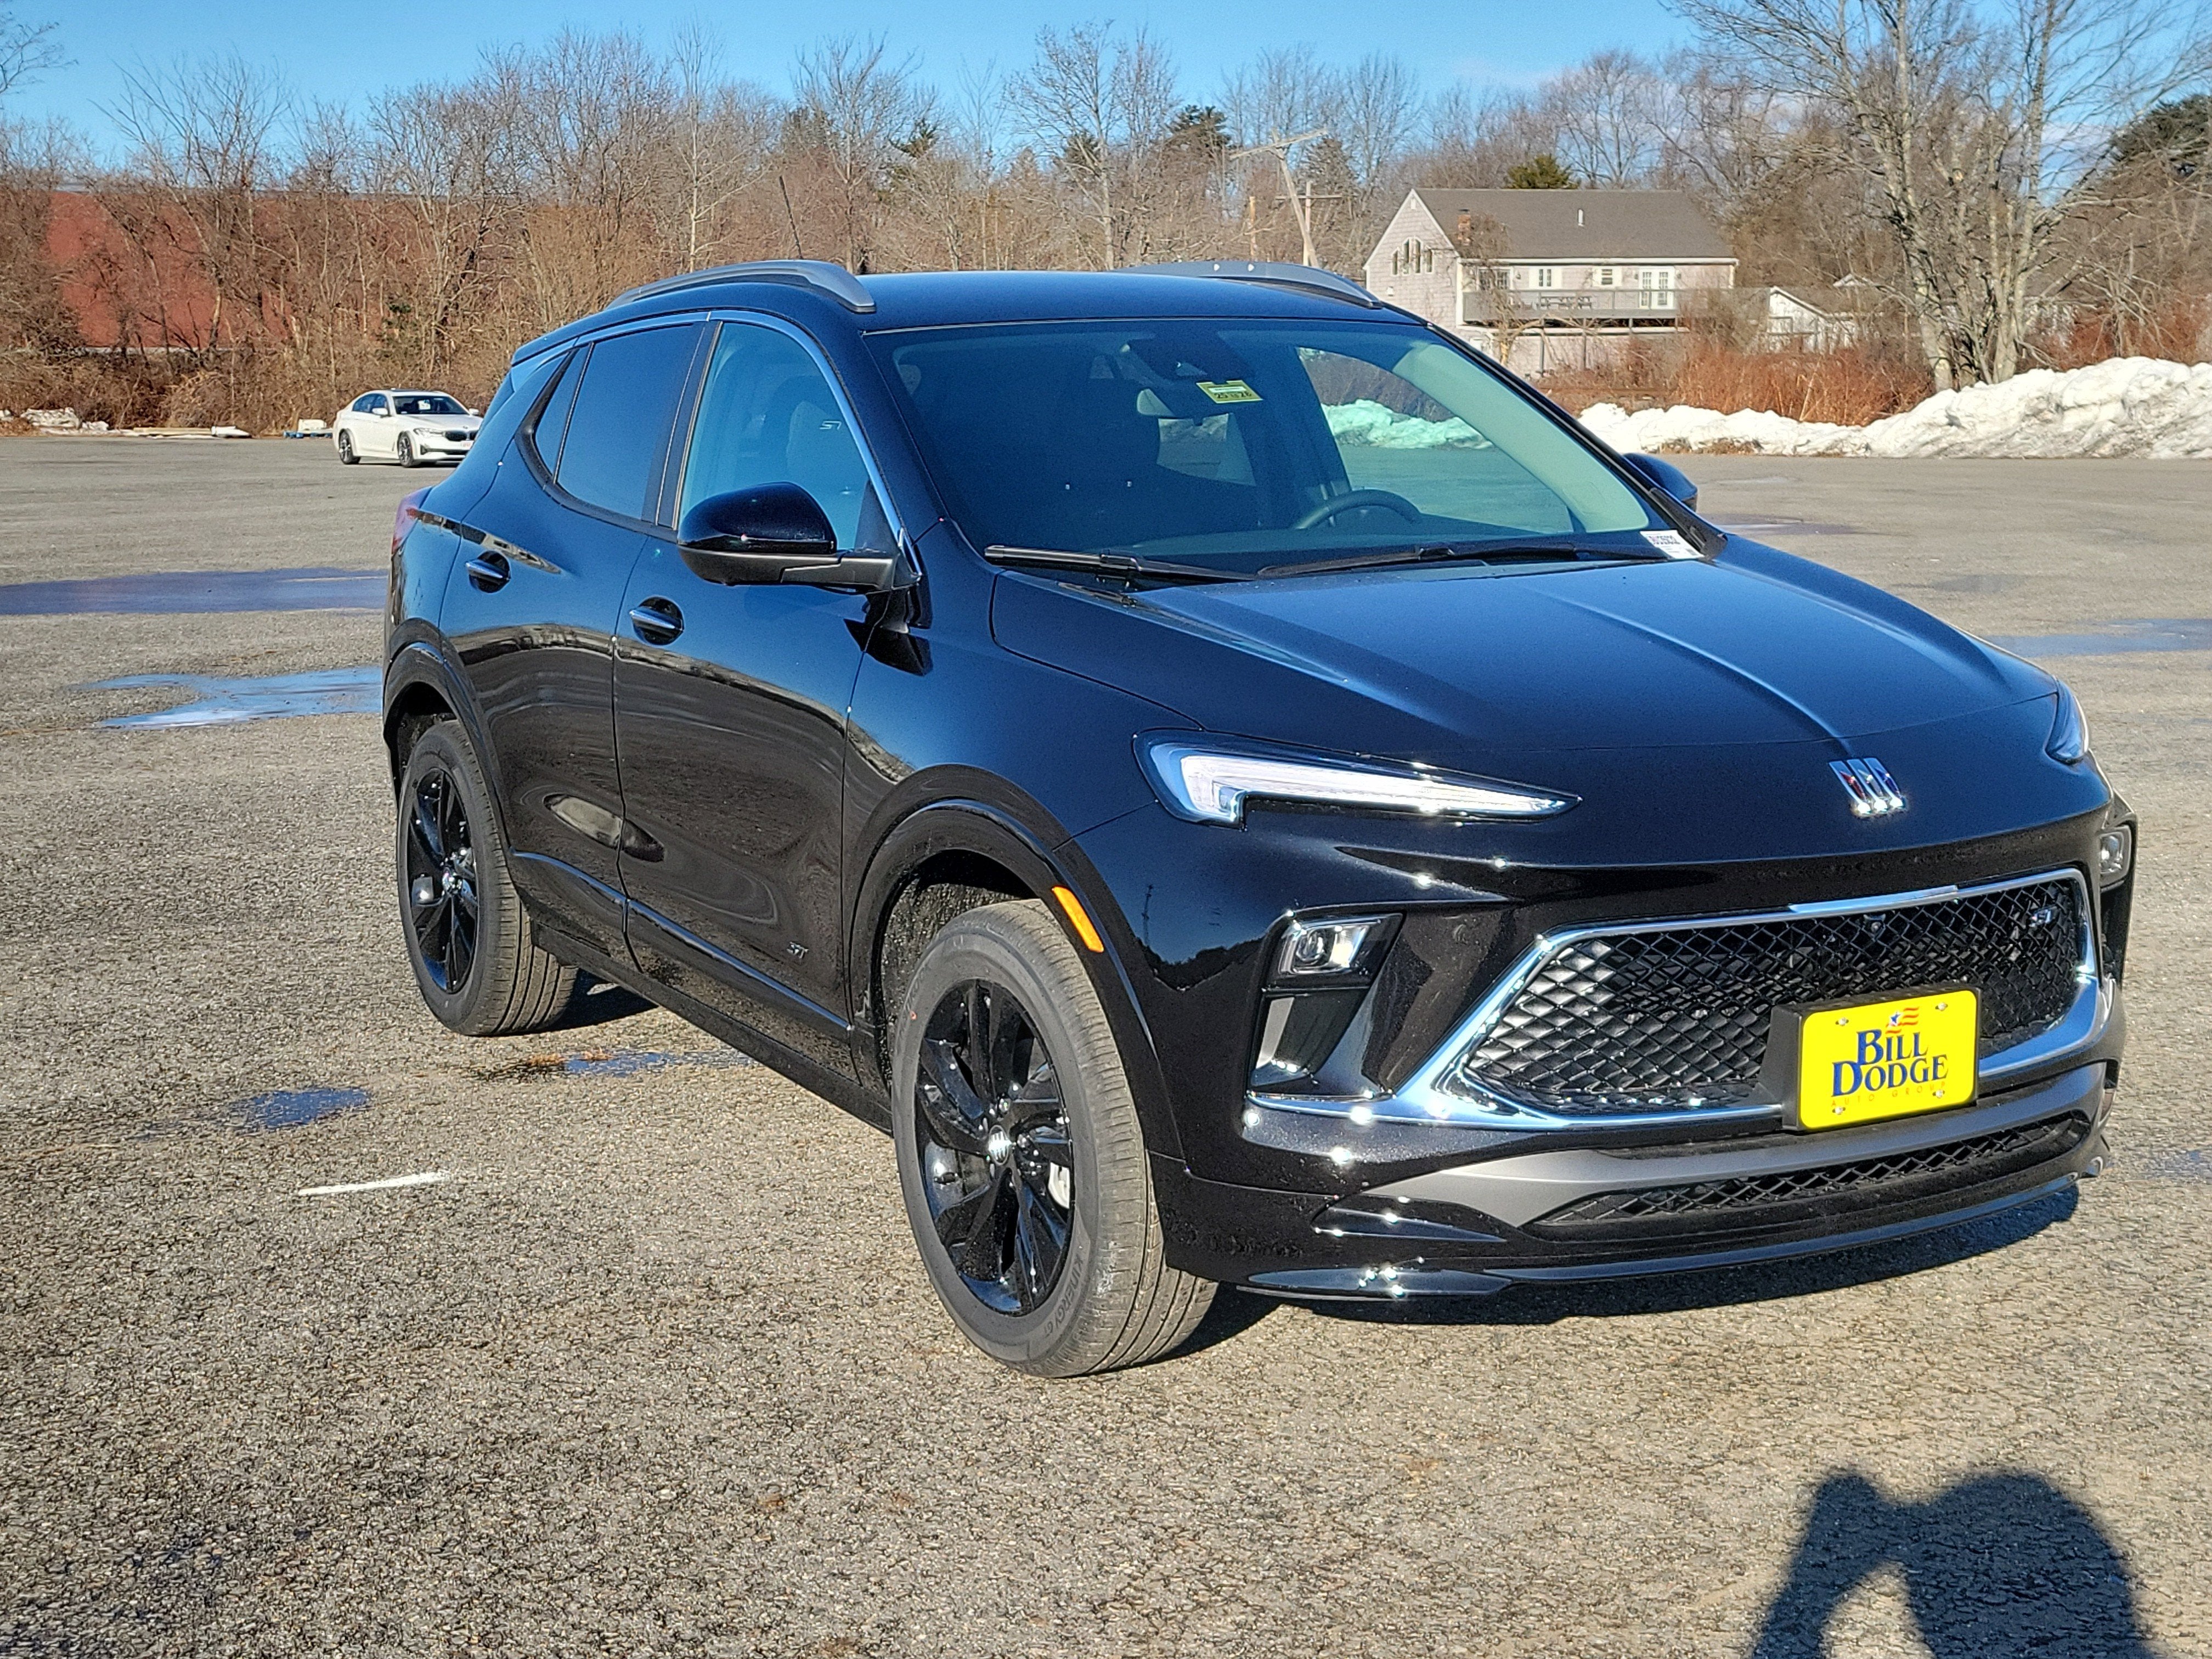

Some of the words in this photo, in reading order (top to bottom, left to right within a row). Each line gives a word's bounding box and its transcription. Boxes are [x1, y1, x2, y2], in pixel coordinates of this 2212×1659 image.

[1857, 1029, 1928, 1065] BILL
[1831, 1054, 1949, 1097] DODGE
[1831, 1093, 1875, 1107] AUTO
[1892, 1081, 1946, 1098] GROUP
[1054, 1254, 1084, 1328] KINERGY
